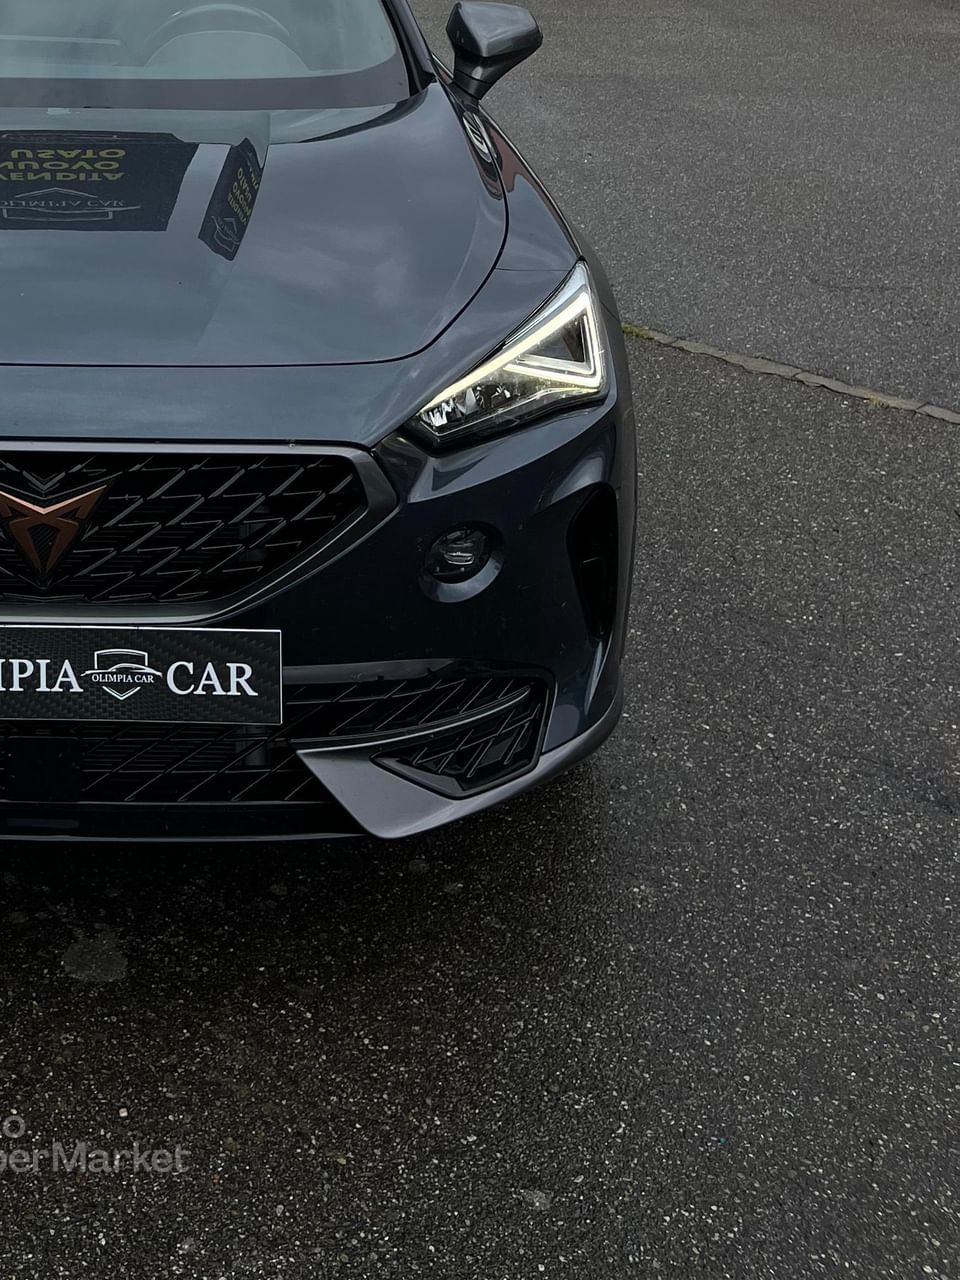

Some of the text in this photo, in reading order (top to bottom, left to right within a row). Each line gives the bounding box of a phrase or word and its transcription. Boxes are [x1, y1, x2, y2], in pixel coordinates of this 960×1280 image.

[91, 672, 154, 684] OLIMPIA CAR
[166, 661, 259, 696] CAR
